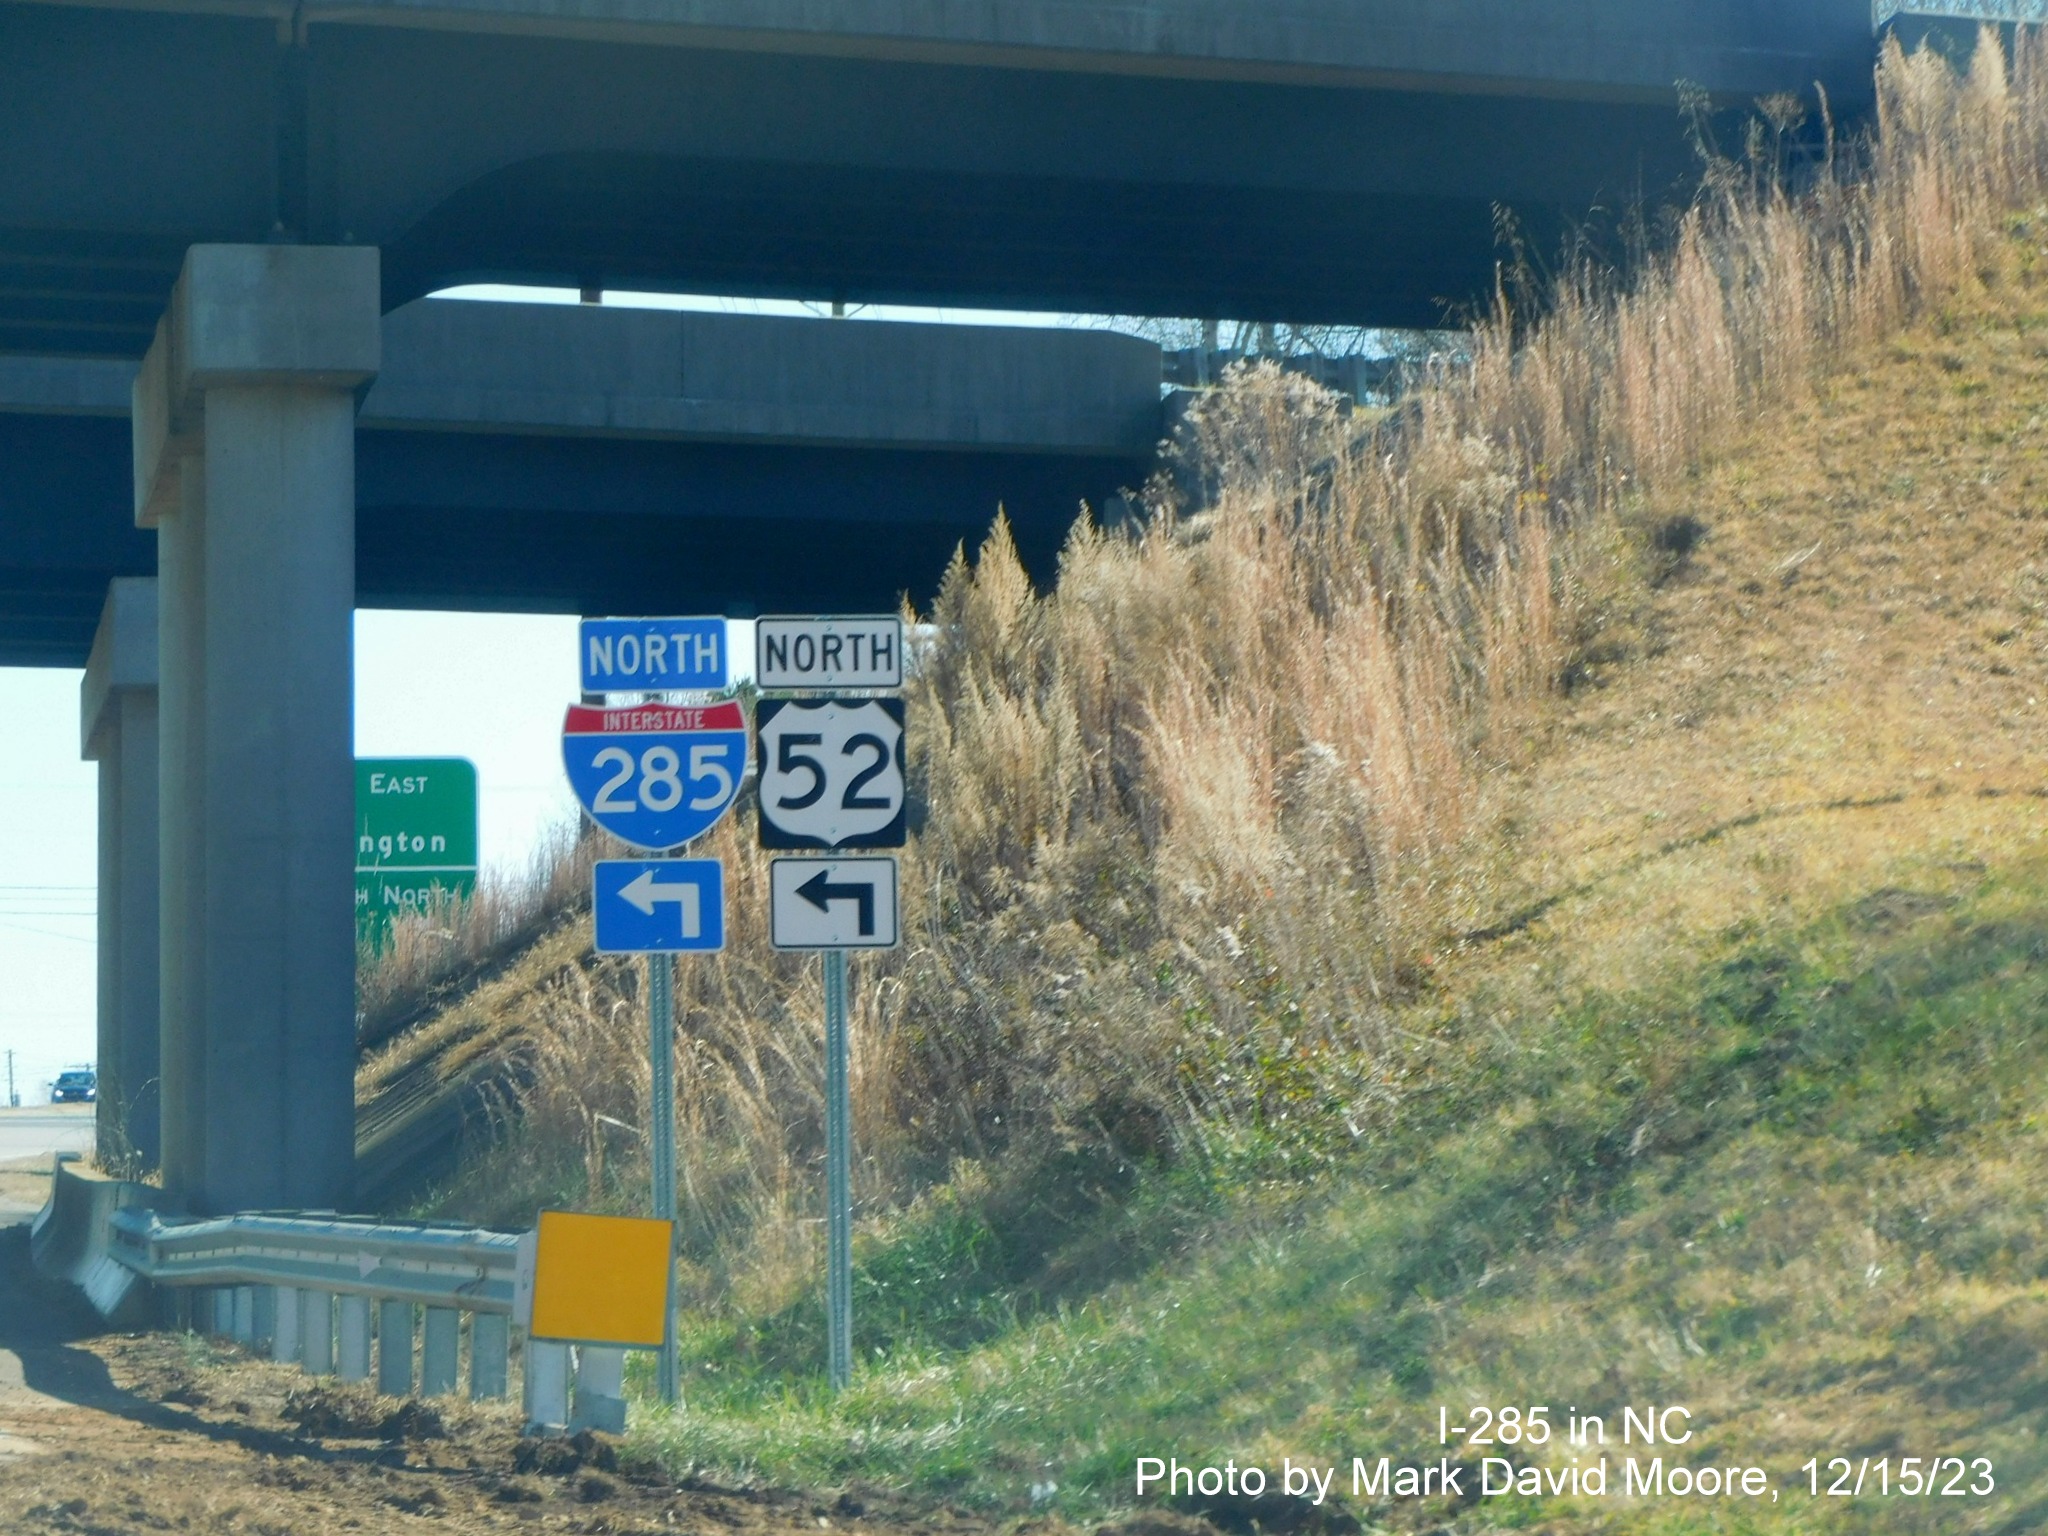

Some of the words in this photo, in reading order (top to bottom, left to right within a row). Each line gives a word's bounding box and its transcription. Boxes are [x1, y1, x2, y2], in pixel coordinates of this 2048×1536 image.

[589, 633, 719, 676] NORTH
[766, 633, 894, 673] NORTH
[603, 710, 706, 731] INTERSTATE
[370, 773, 429, 795] EAST
[591, 744, 734, 814] 285
[776, 732, 892, 811] 52
